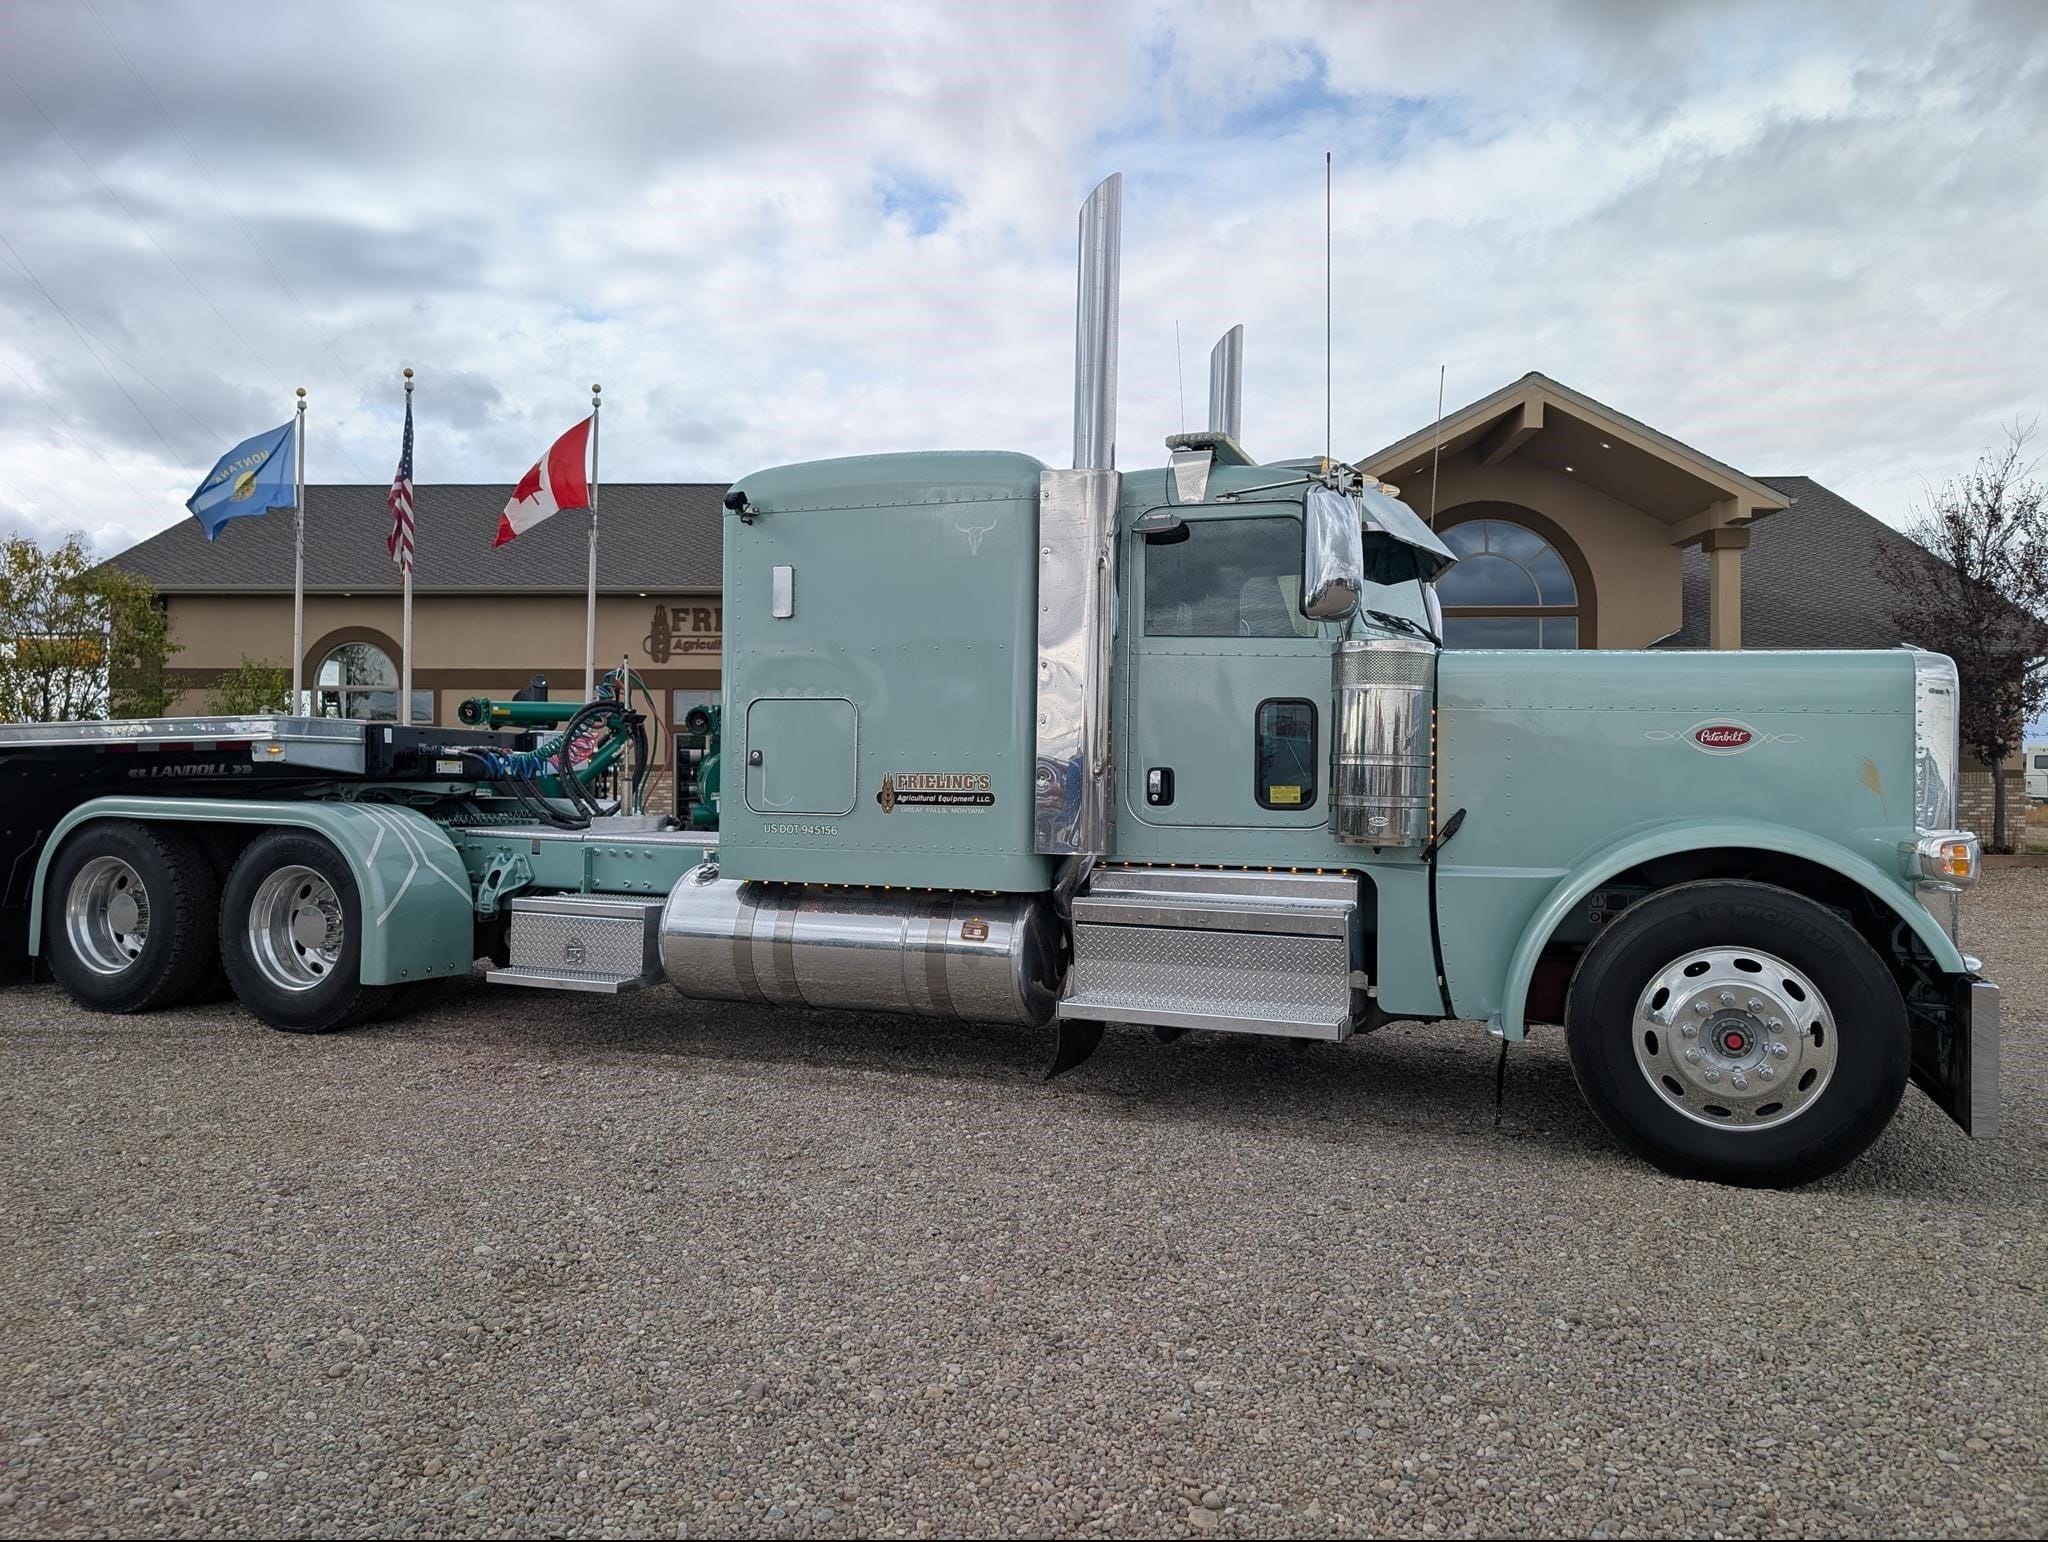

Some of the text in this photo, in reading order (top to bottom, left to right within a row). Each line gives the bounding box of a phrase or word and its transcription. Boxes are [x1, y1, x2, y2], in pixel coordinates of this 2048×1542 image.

[1701, 729, 1747, 742] Peterbilt
[150, 763, 229, 777] LANDOLL
[897, 774, 991, 791] FRIELING'S
[897, 795, 936, 804] Agricultural
[938, 795, 975, 804] Equipment
[901, 806, 923, 814] GREAT
[764, 823, 838, 835] US DOT 945156
